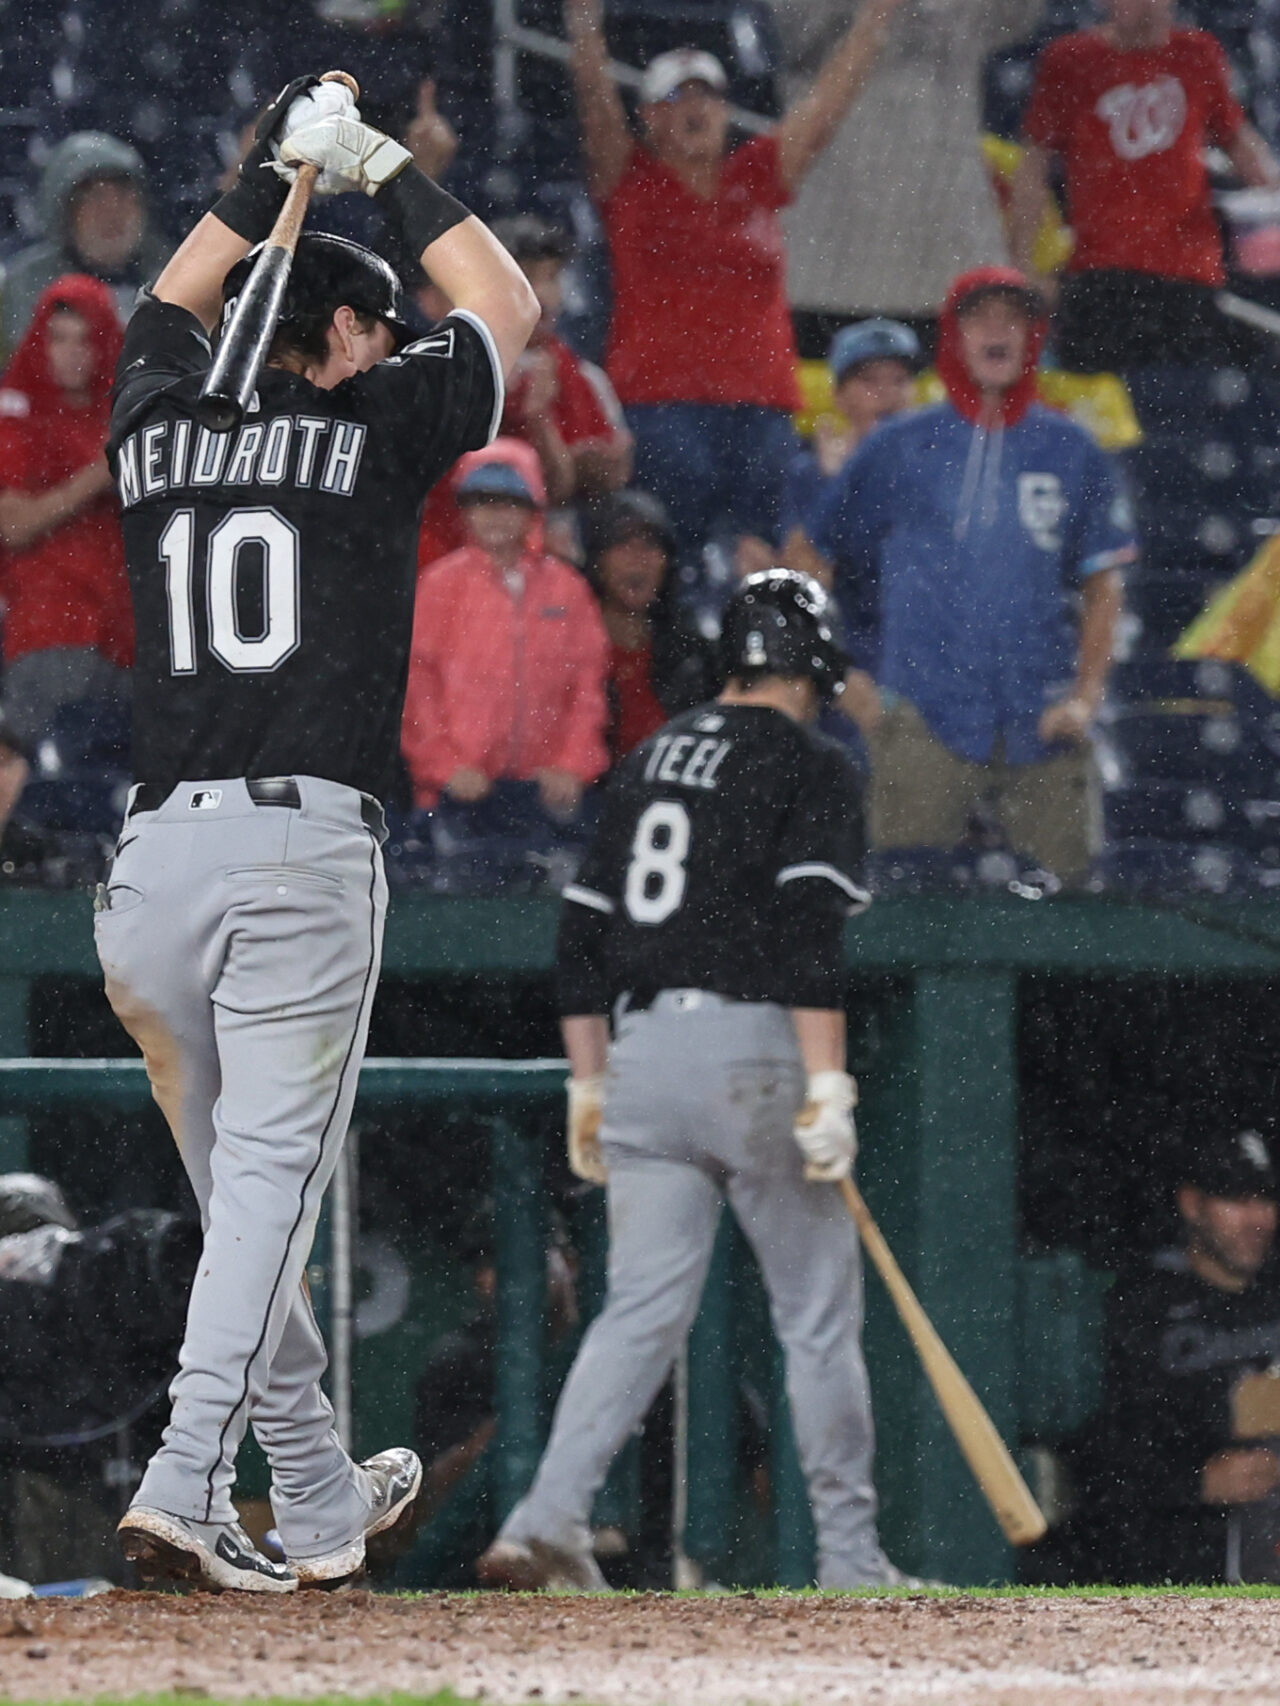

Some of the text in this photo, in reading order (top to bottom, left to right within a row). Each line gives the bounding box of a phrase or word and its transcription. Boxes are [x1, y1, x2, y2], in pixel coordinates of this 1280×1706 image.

[119, 415, 367, 507] MEIDROTH
[158, 506, 301, 677] 10
[644, 735, 732, 788] TEEL
[623, 799, 692, 926] 8
